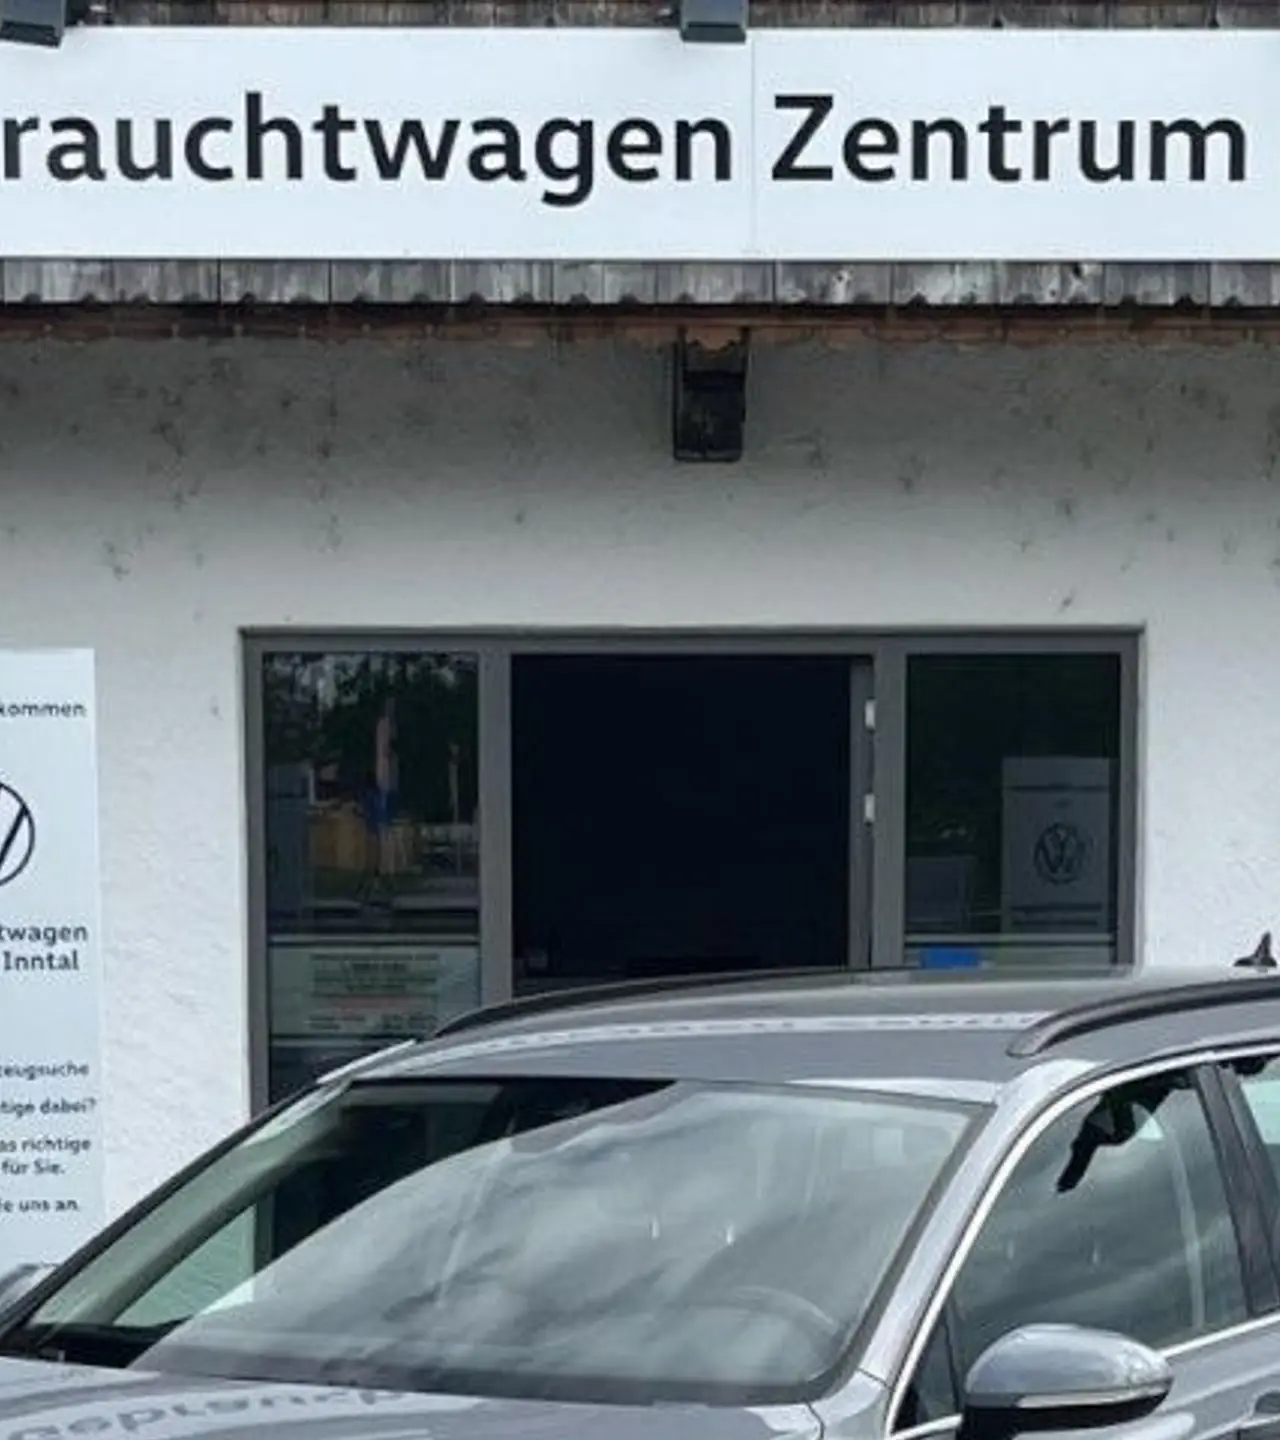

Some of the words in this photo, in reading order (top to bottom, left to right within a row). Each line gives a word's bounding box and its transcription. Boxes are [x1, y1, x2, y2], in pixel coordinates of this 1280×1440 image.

[770, 94, 1247, 183] Zentrum
[3, 948, 81, 972] Inntal
[39, 1098, 97, 1115] dabei?
[21, 1137, 92, 1156] richtige
[1, 1159, 29, 1176] für
[33, 1159, 66, 1176] Sie.
[18, 1199, 51, 1214] uns
